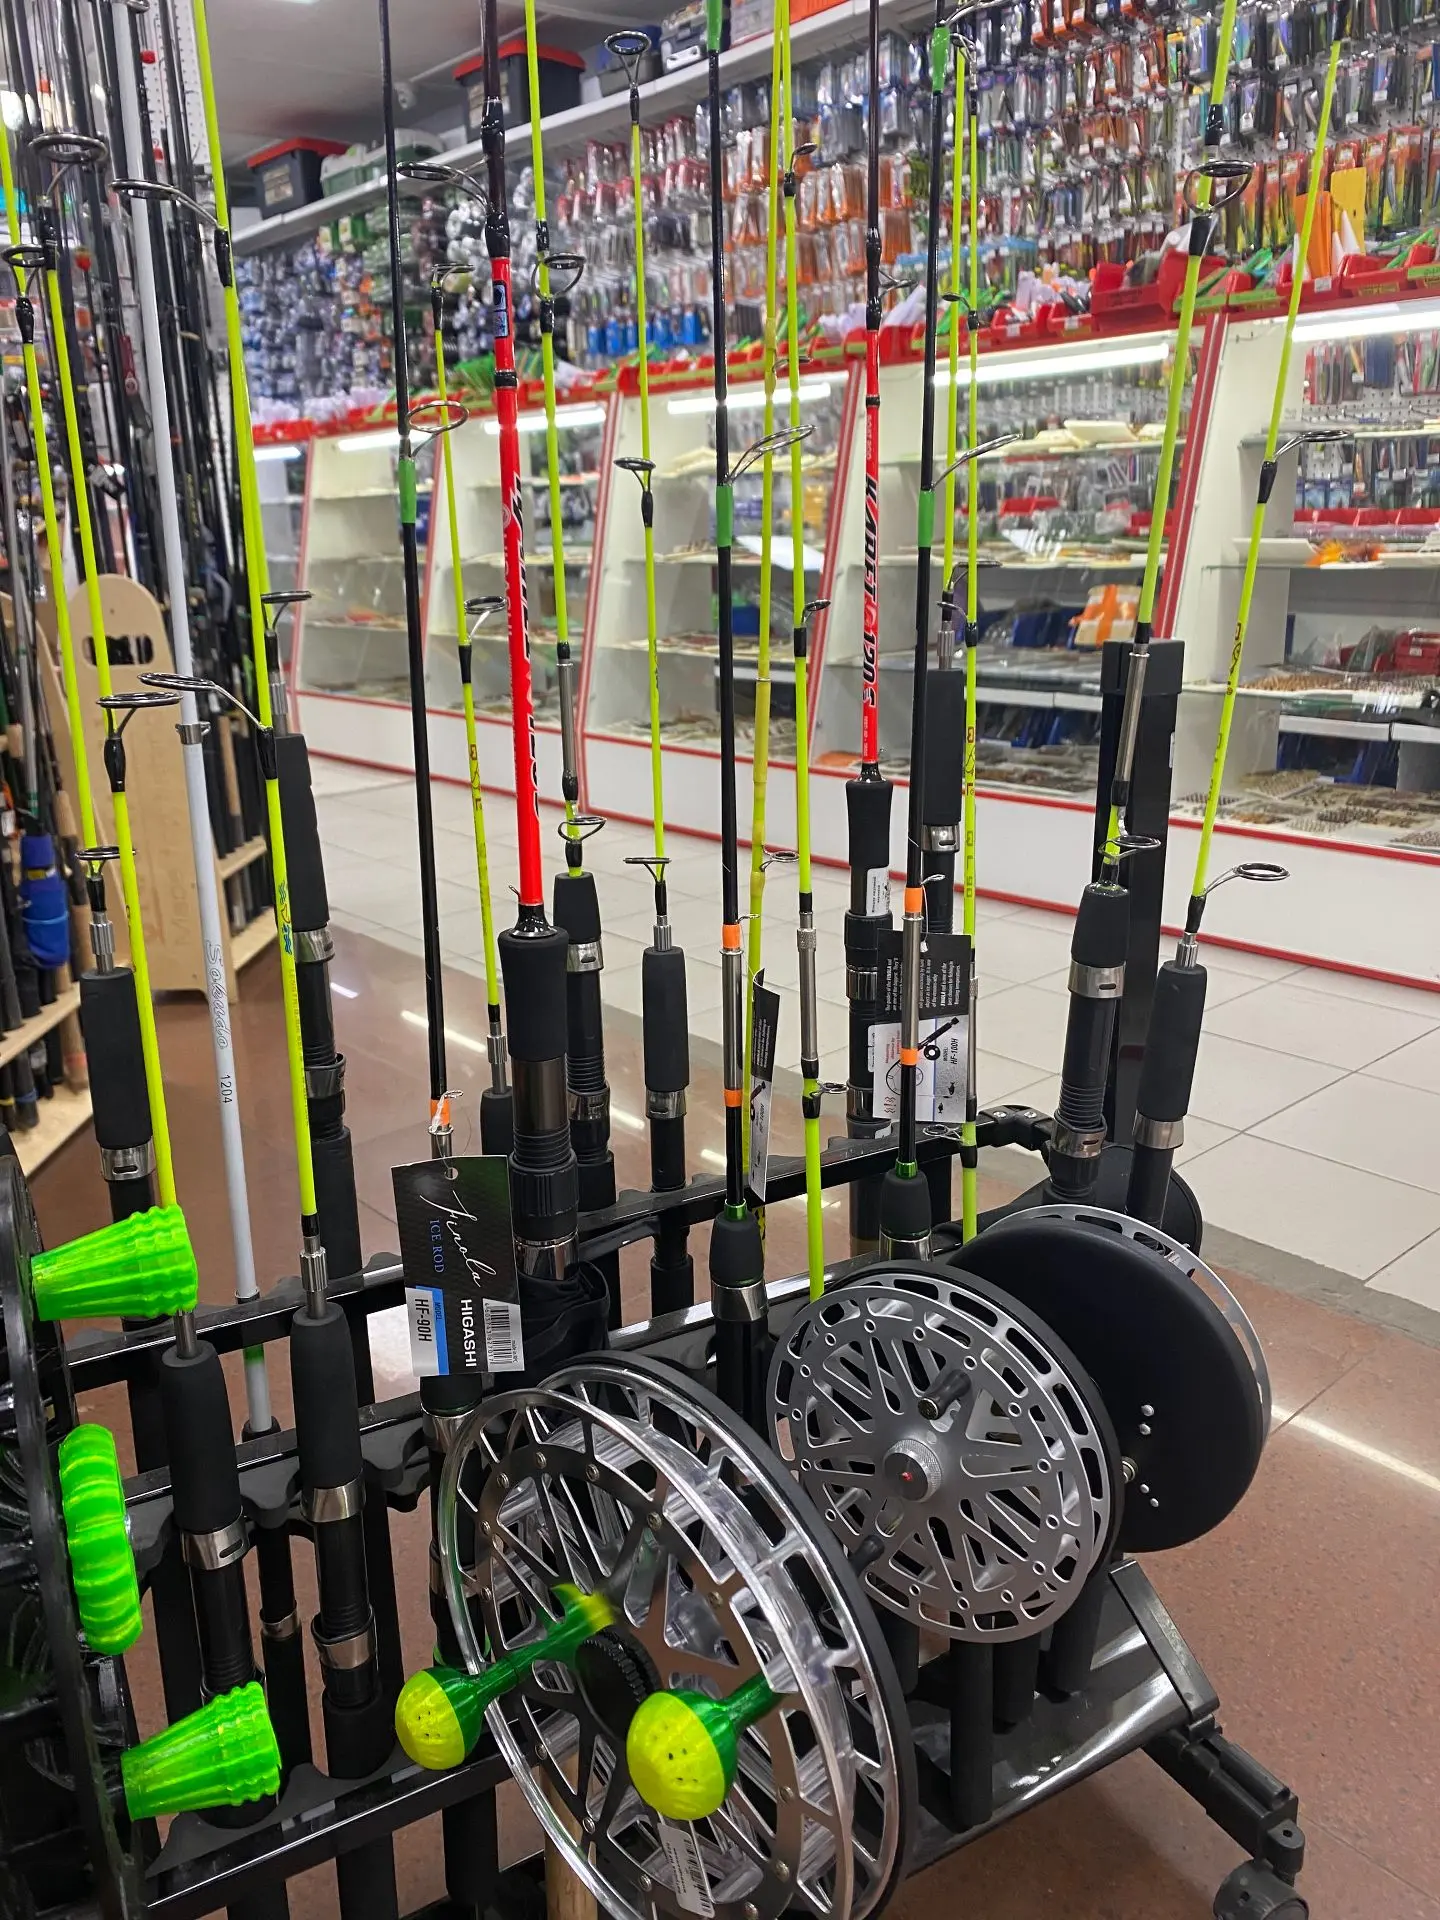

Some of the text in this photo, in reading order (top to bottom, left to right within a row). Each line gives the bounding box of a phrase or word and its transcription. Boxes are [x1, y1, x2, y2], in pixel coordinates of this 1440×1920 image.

[951, 1037, 959, 1065] HF-100H
[220, 1074, 233, 1104] 1204
[420, 1190, 497, 1288] Finola
[430, 1219, 445, 1274] ICE ROD
[415, 1298, 432, 1342] HF-90H
[460, 1299, 478, 1367] HIGASHI
